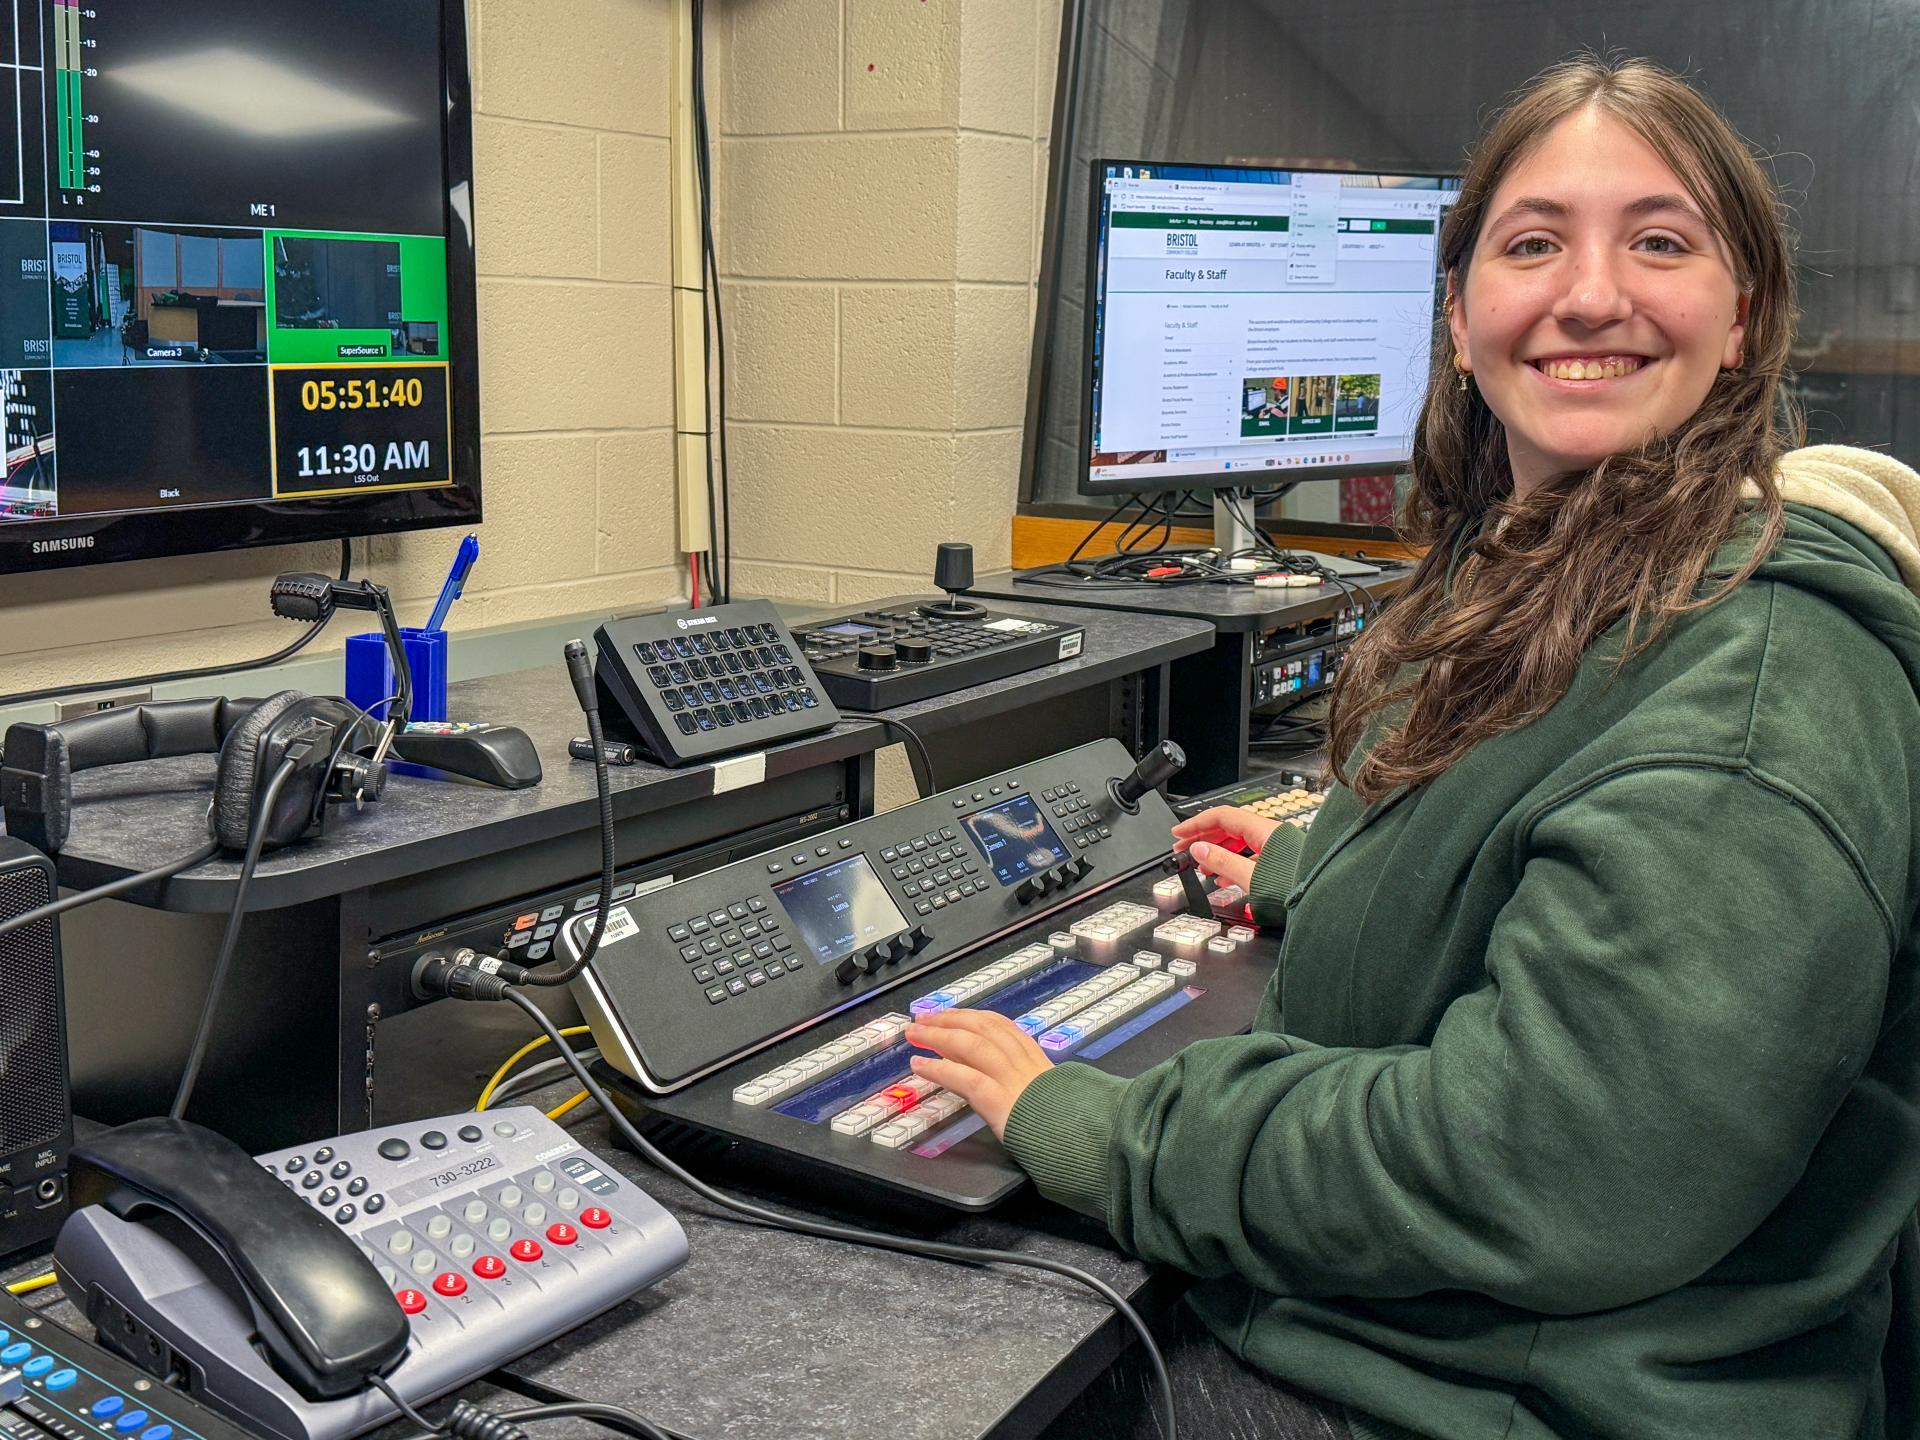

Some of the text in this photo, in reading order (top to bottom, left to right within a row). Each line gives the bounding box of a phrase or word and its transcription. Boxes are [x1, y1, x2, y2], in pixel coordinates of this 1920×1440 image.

[62, 195, 84, 205] L R
[250, 203, 276, 217] ME 1
[1166, 233, 1198, 247] BRISTOL
[57, 253, 82, 264] BRISTOL
[1165, 269, 1228, 282] Faculty & Staff
[147, 347, 182, 357] Camera 3
[340, 346, 379, 356] SuperSource
[302, 378, 422, 411] 05:51:40
[297, 440, 430, 477] 11:30 AM
[366, 474, 380, 482] Out
[160, 488, 181, 498] Black
[33, 536, 94, 554] SAMSUNG
[832, 901, 850, 912] Luma
[38, 1150, 53, 1160] MIC
[320, 1148, 330, 1156] 3
[35, 1155, 57, 1169] INPUT
[292, 1157, 302, 1165] 2
[309, 1172, 319, 1180] 5
[429, 1157, 495, 1187] 730-3222
[524, 1241, 532, 1254] DROP
[446, 1274, 454, 1287] DROP
[406, 1291, 414, 1305] DROP
